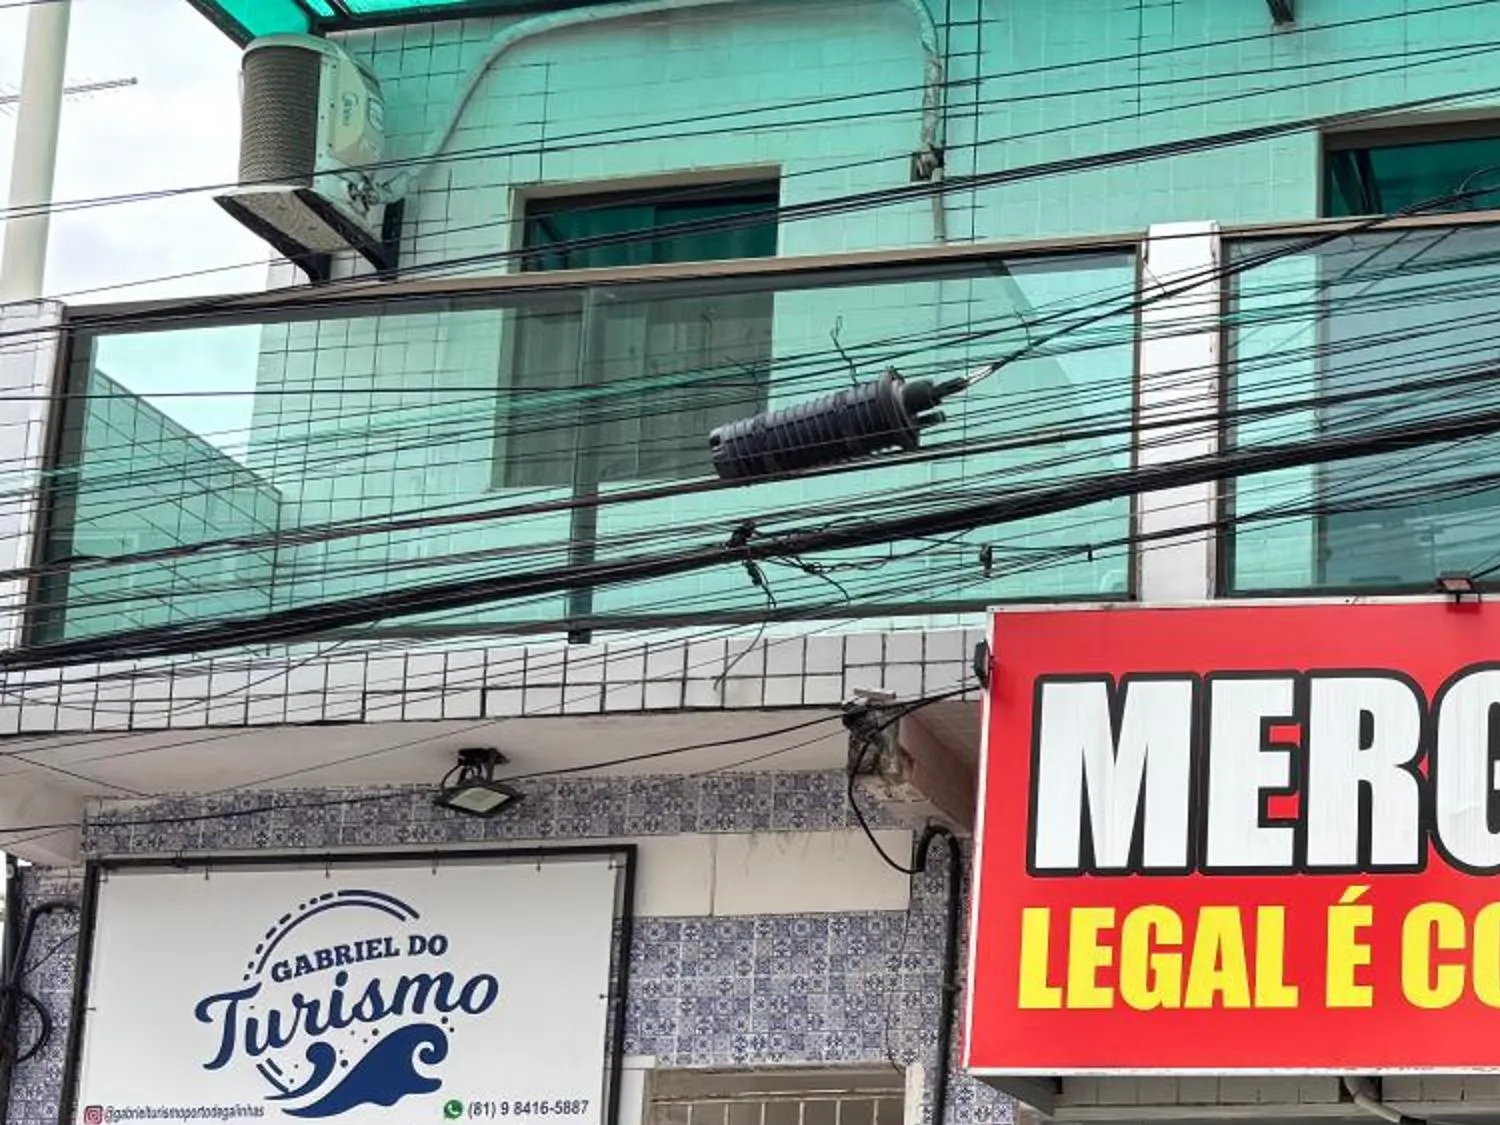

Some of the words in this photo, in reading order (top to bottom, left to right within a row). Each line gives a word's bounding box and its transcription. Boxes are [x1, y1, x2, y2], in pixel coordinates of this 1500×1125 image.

[271, 937, 400, 983] GABRIEL
[407, 934, 449, 957] DO
[1018, 906, 1298, 1010] LEGAL
[1326, 885, 1373, 1007] É
[194, 971, 499, 1071] Turismo
[468, 1101, 497, 1118] (81)
[501, 1101, 509, 1115] 9
[513, 1099, 589, 1115] 8416-5887
